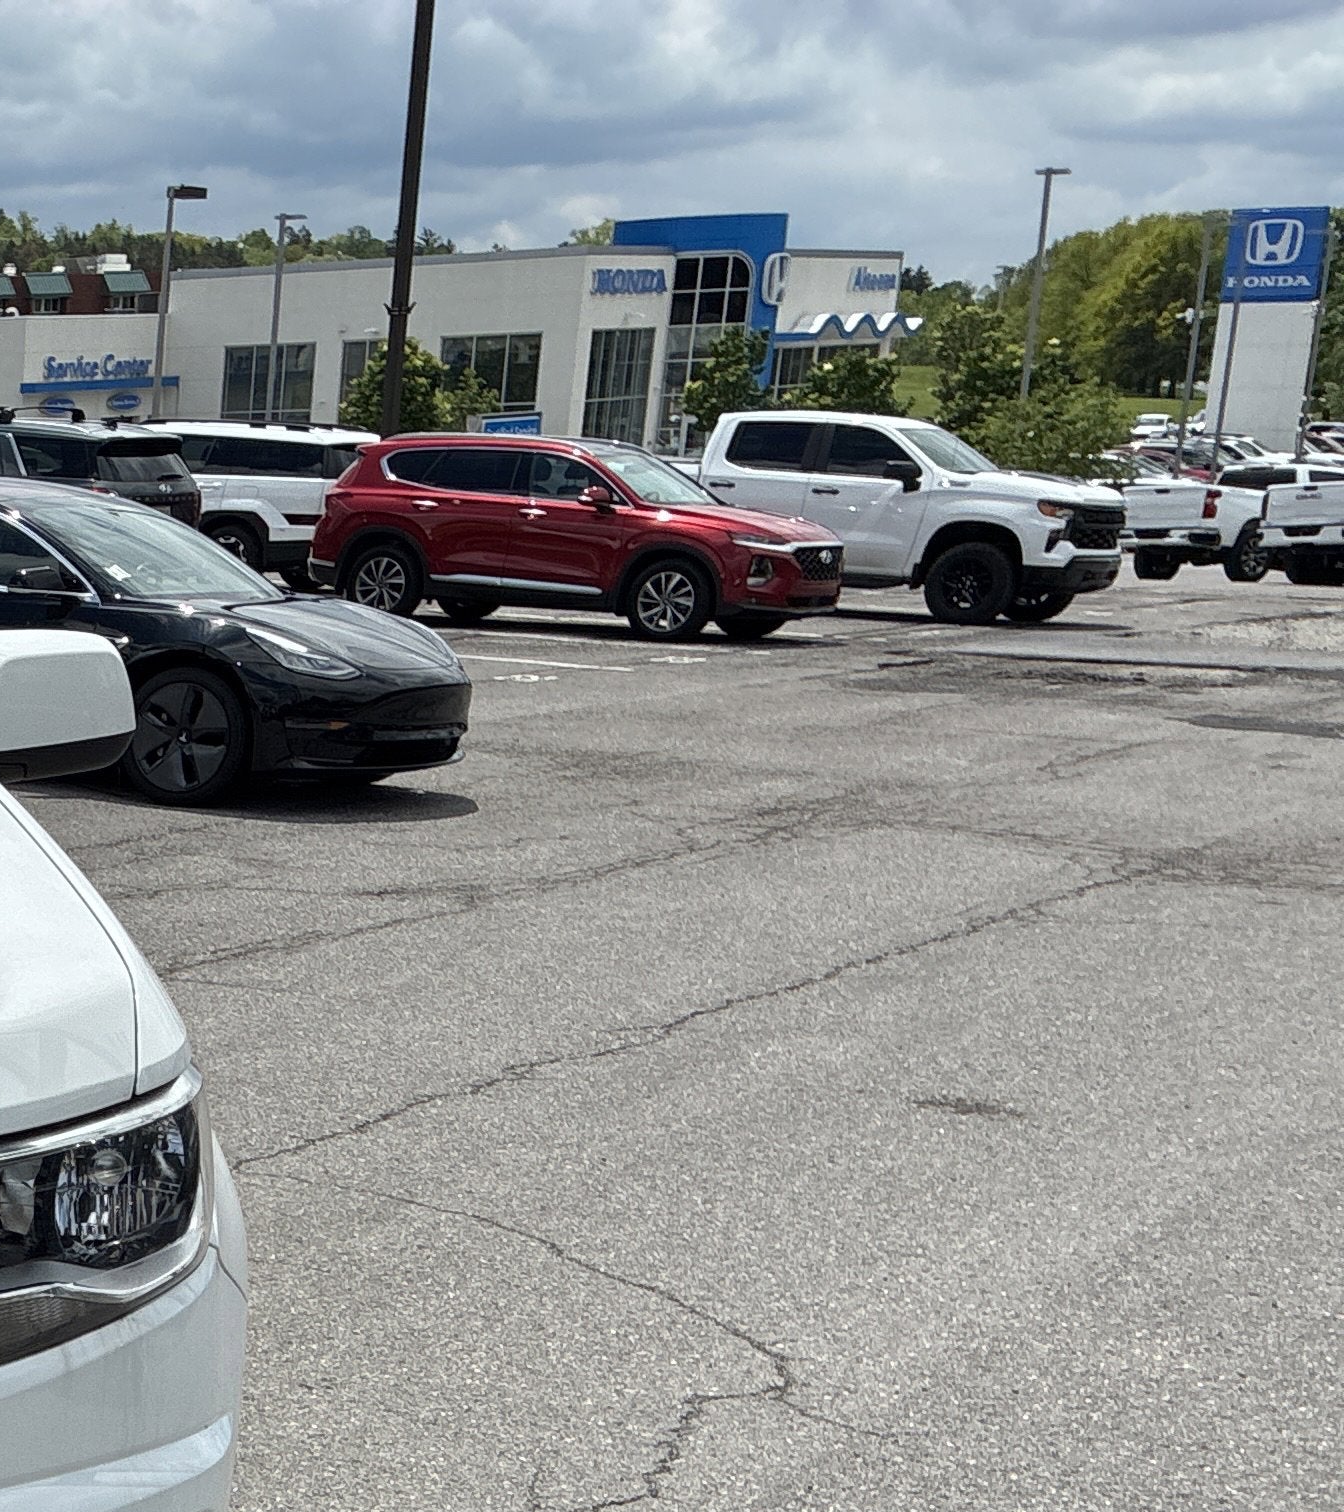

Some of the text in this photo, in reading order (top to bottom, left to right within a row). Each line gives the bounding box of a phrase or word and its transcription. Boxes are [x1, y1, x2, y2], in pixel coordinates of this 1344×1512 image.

[592, 269, 667, 293] HONDA
[44, 353, 152, 378] Service Center
